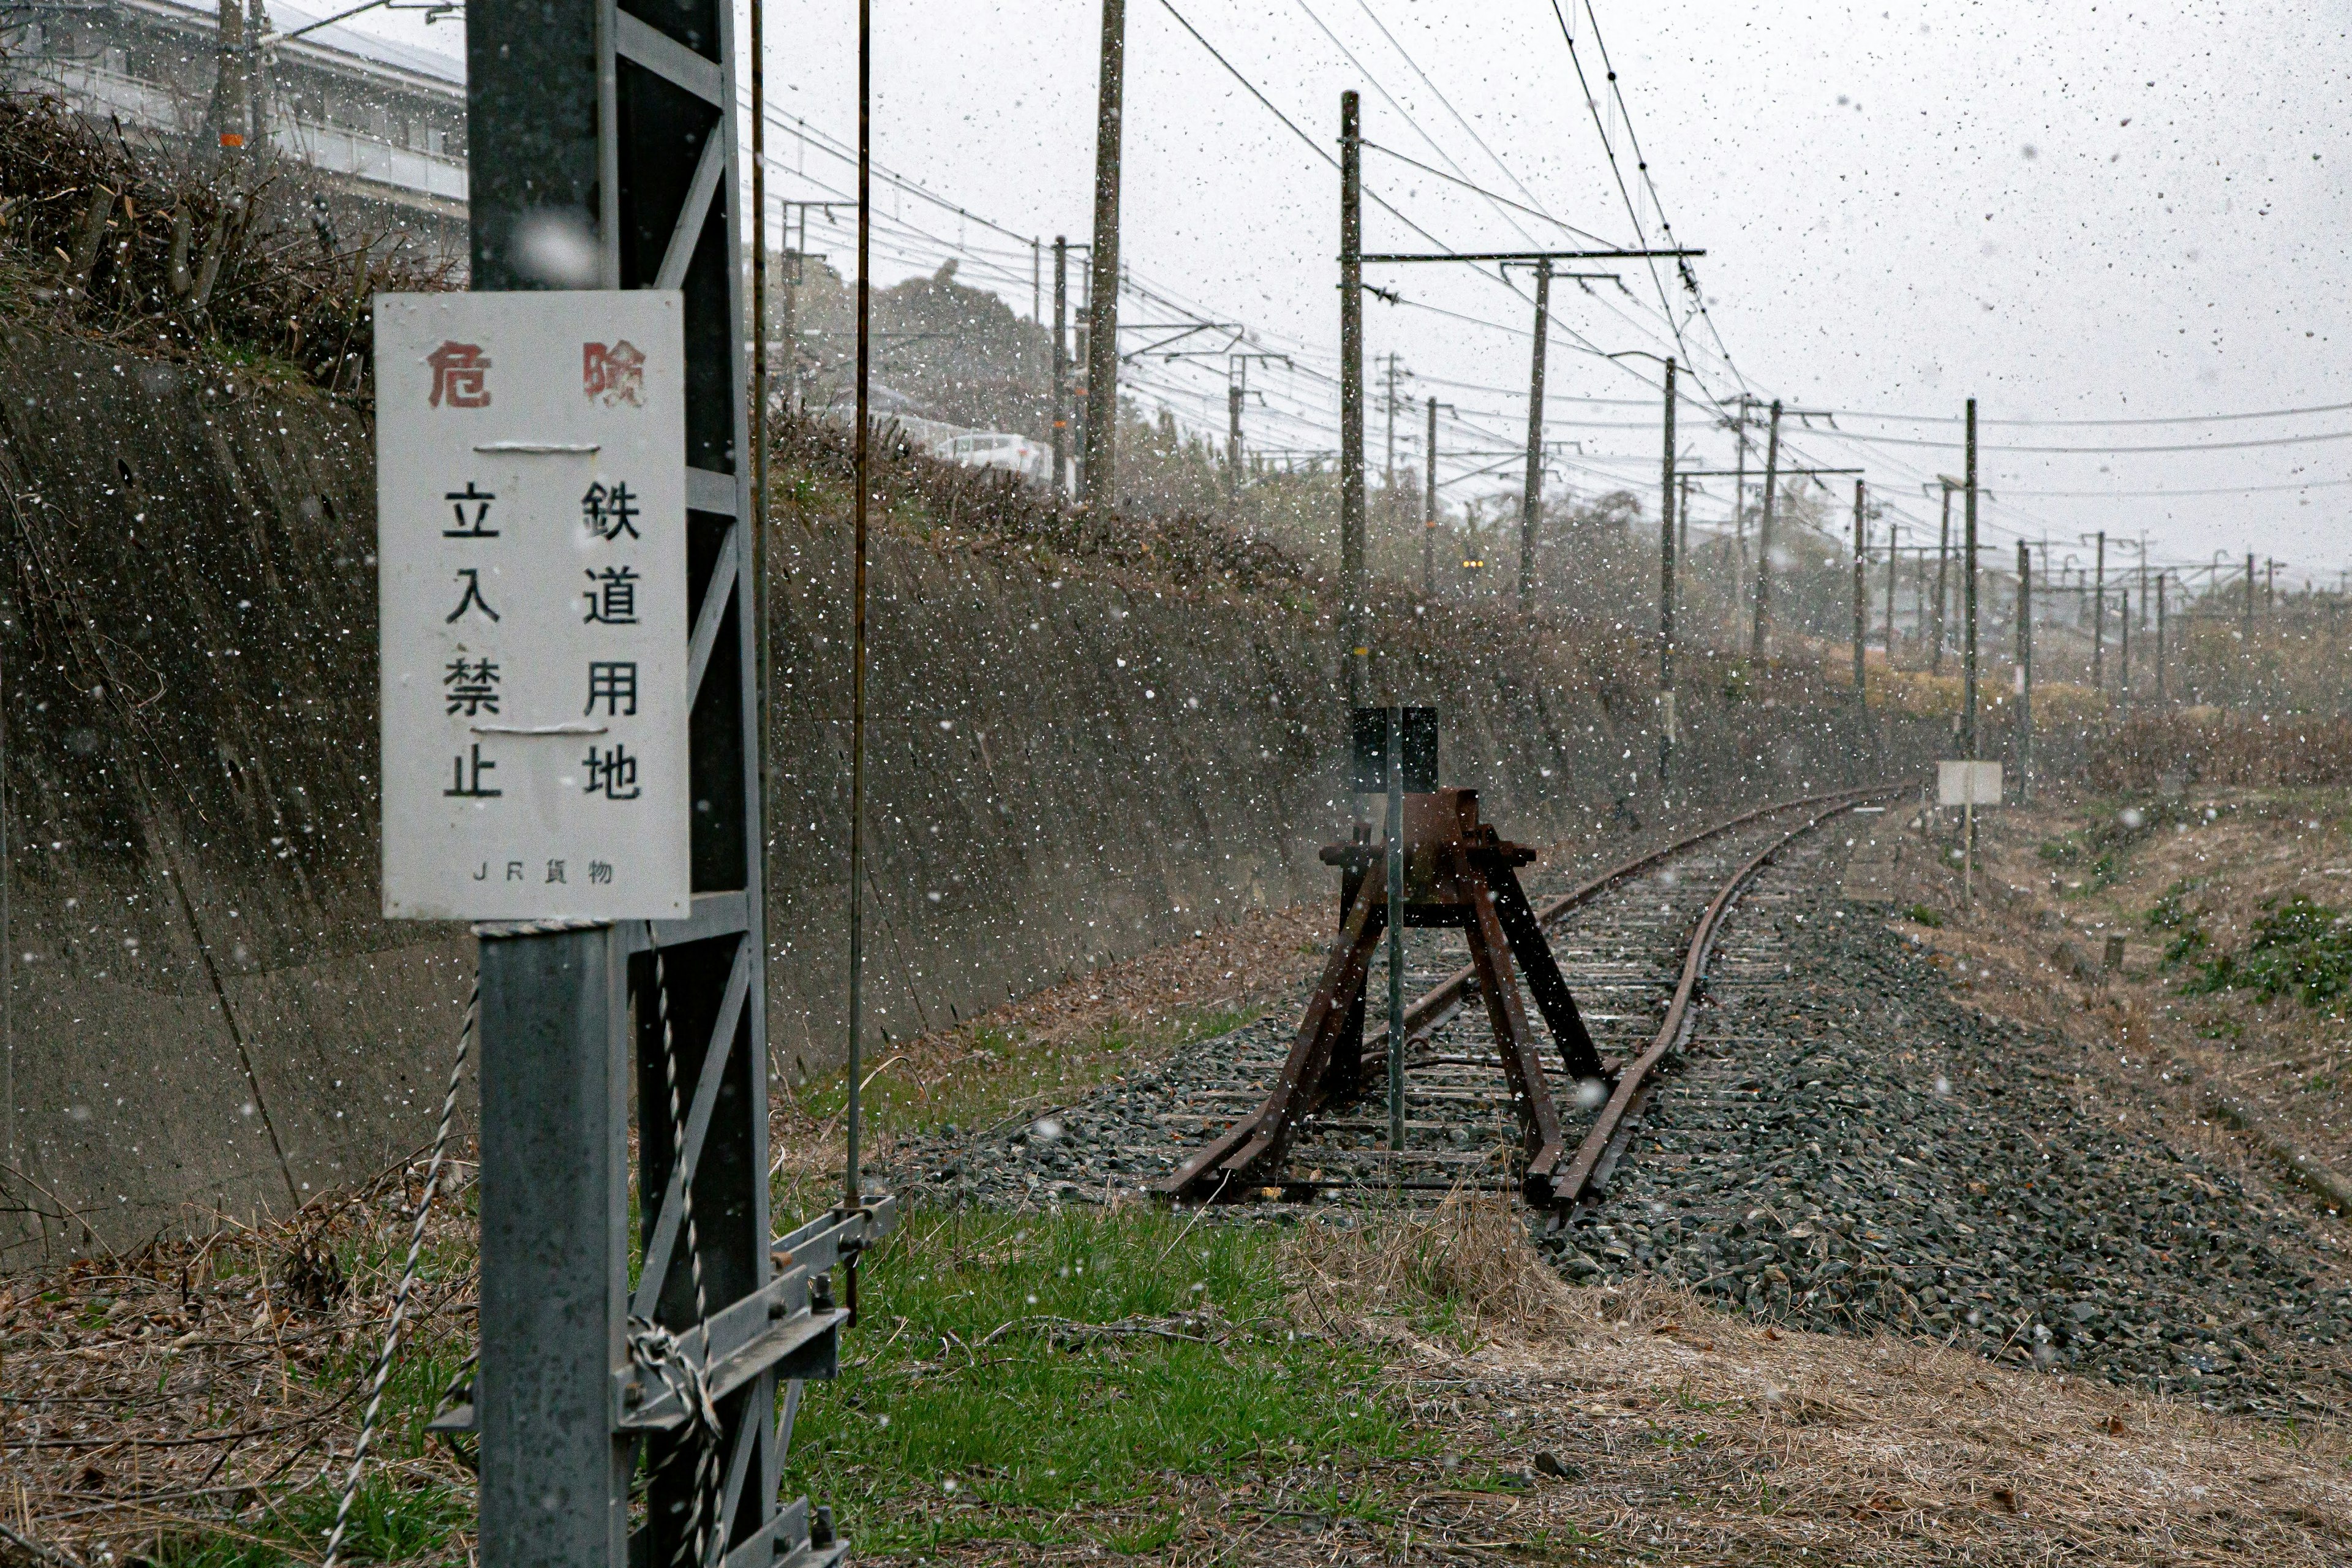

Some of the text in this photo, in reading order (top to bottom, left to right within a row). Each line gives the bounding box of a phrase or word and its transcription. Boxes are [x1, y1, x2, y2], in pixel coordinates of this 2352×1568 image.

[427, 339, 647, 409] 危険
[442, 481, 502, 797] 立入禁止
[580, 481, 641, 800] 鉄道用地
[473, 859, 612, 884] JR貨物
